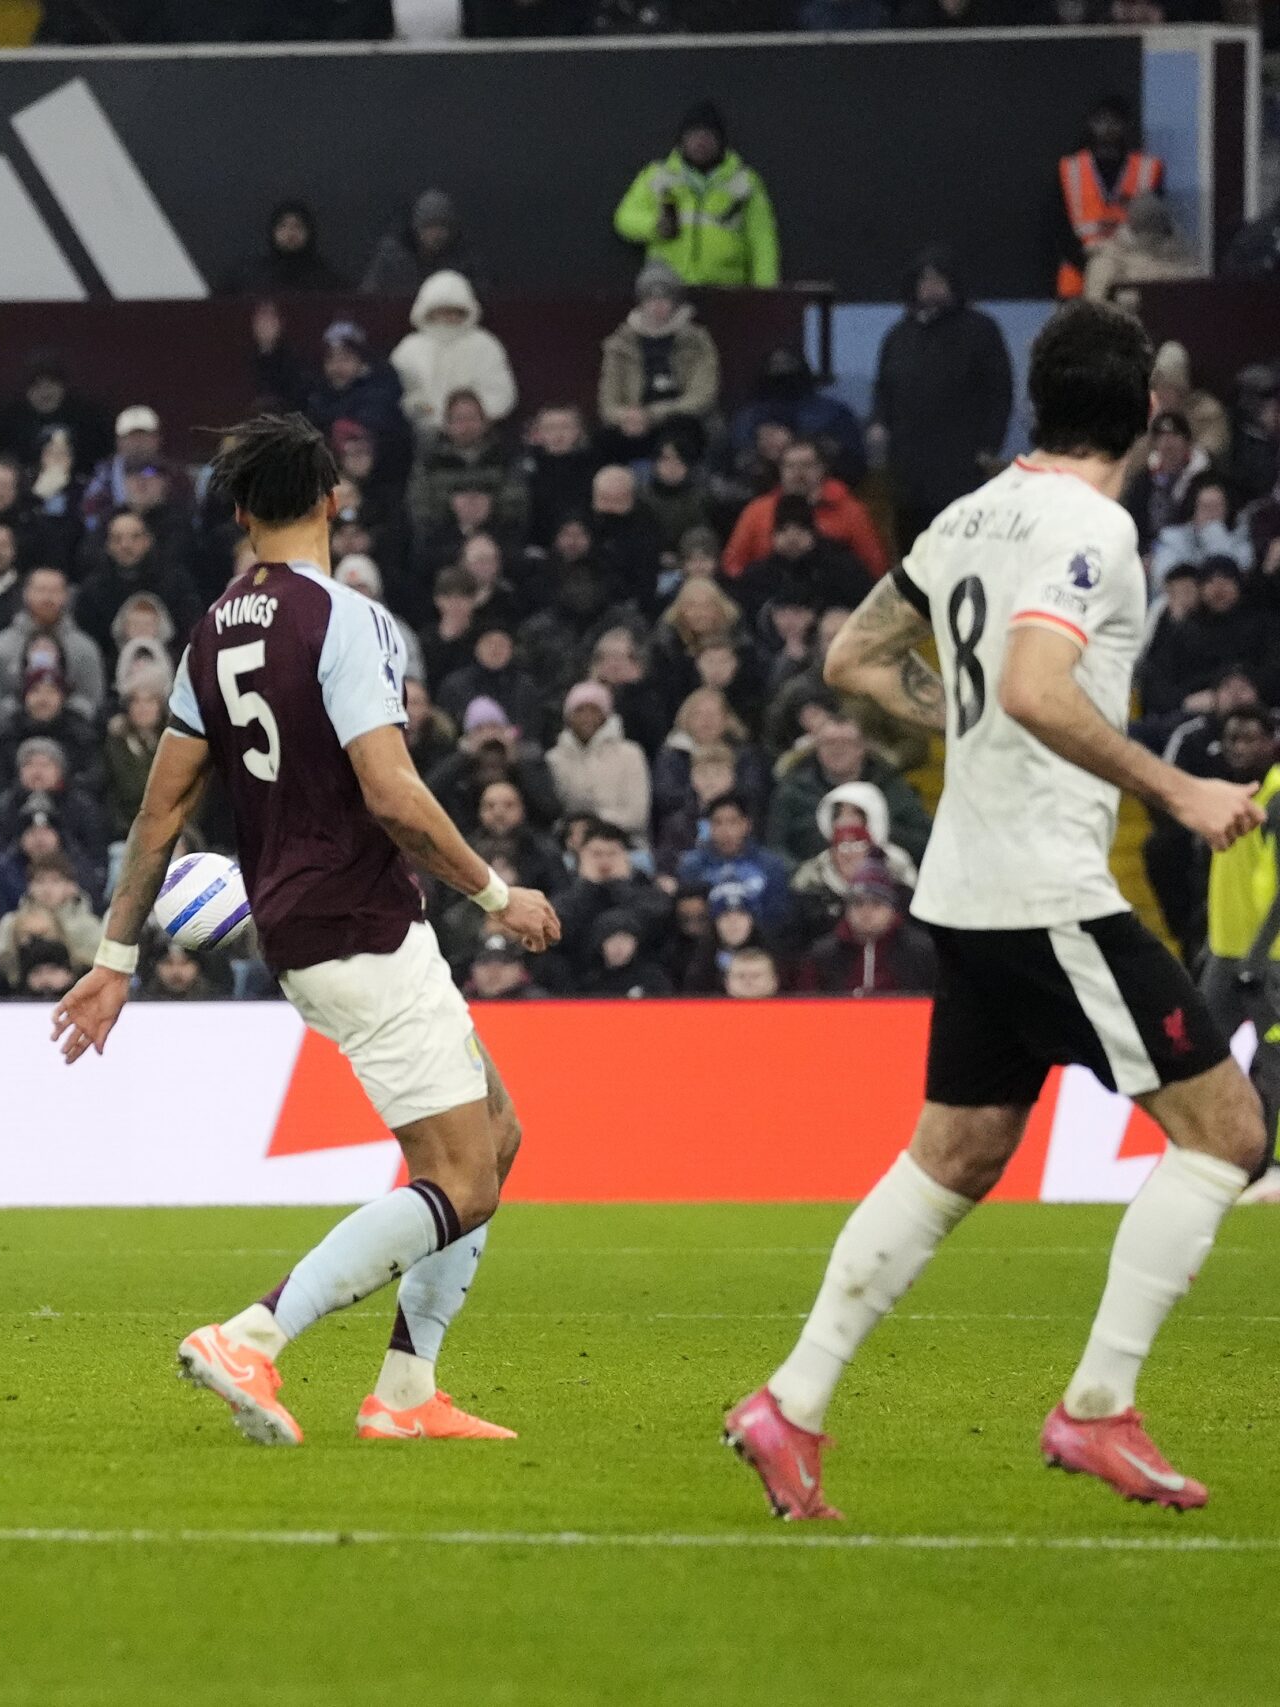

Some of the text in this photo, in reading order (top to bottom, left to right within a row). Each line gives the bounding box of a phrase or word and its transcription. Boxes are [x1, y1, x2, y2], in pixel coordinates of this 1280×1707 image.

[215, 594, 278, 634] MINGS
[949, 576, 986, 738] 8
[217, 640, 280, 781] 5
